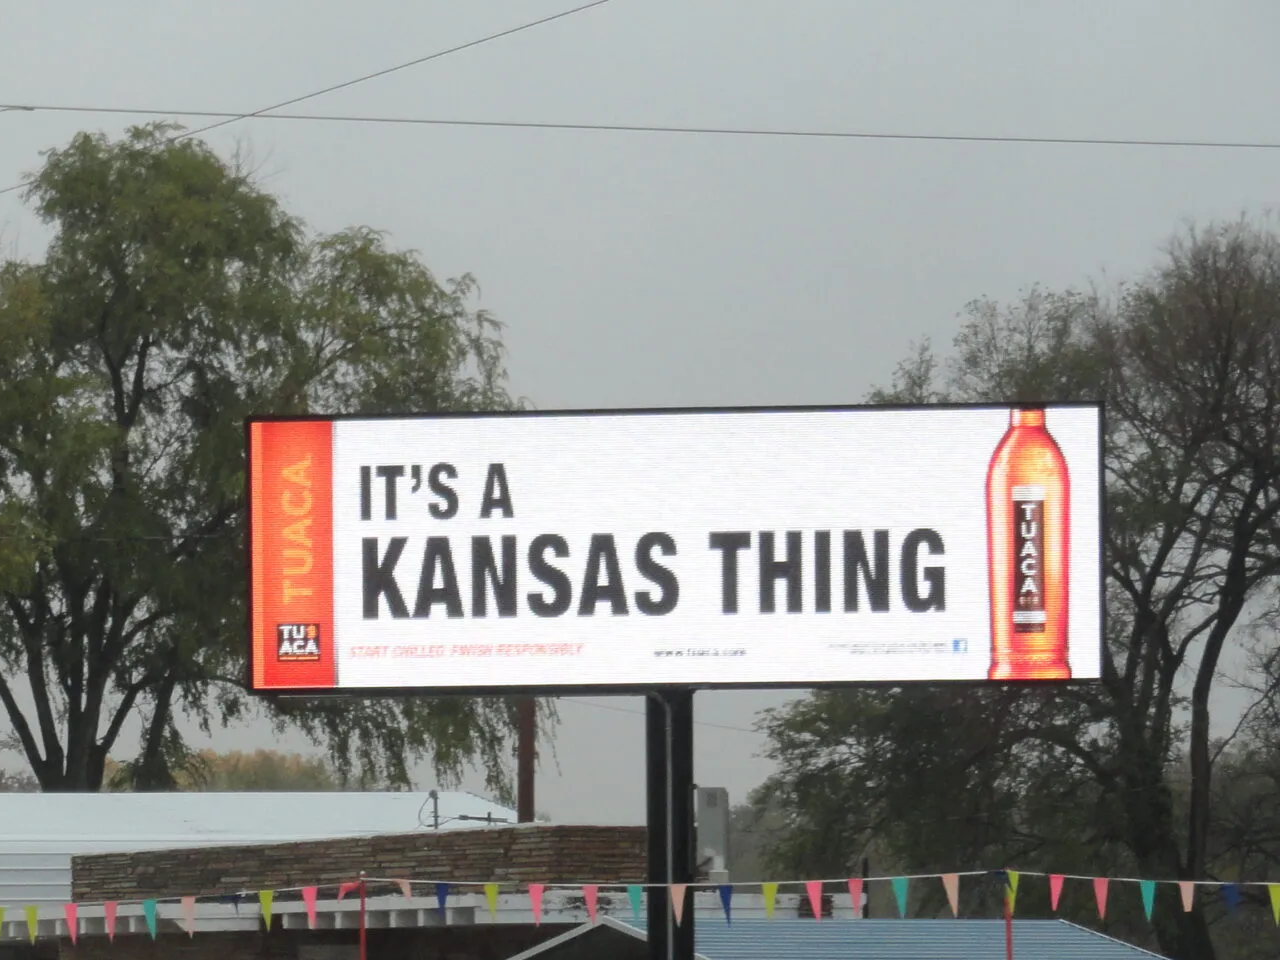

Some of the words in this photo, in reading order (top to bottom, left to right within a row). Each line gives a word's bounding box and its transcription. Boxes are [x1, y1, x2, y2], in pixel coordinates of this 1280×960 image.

[281, 453, 313, 605] TUACA
[359, 462, 459, 521] IT'S
[478, 462, 514, 519] A
[362, 531, 680, 619] KANSAS
[709, 528, 946, 614] THING
[1020, 503, 1038, 594] TUACA
